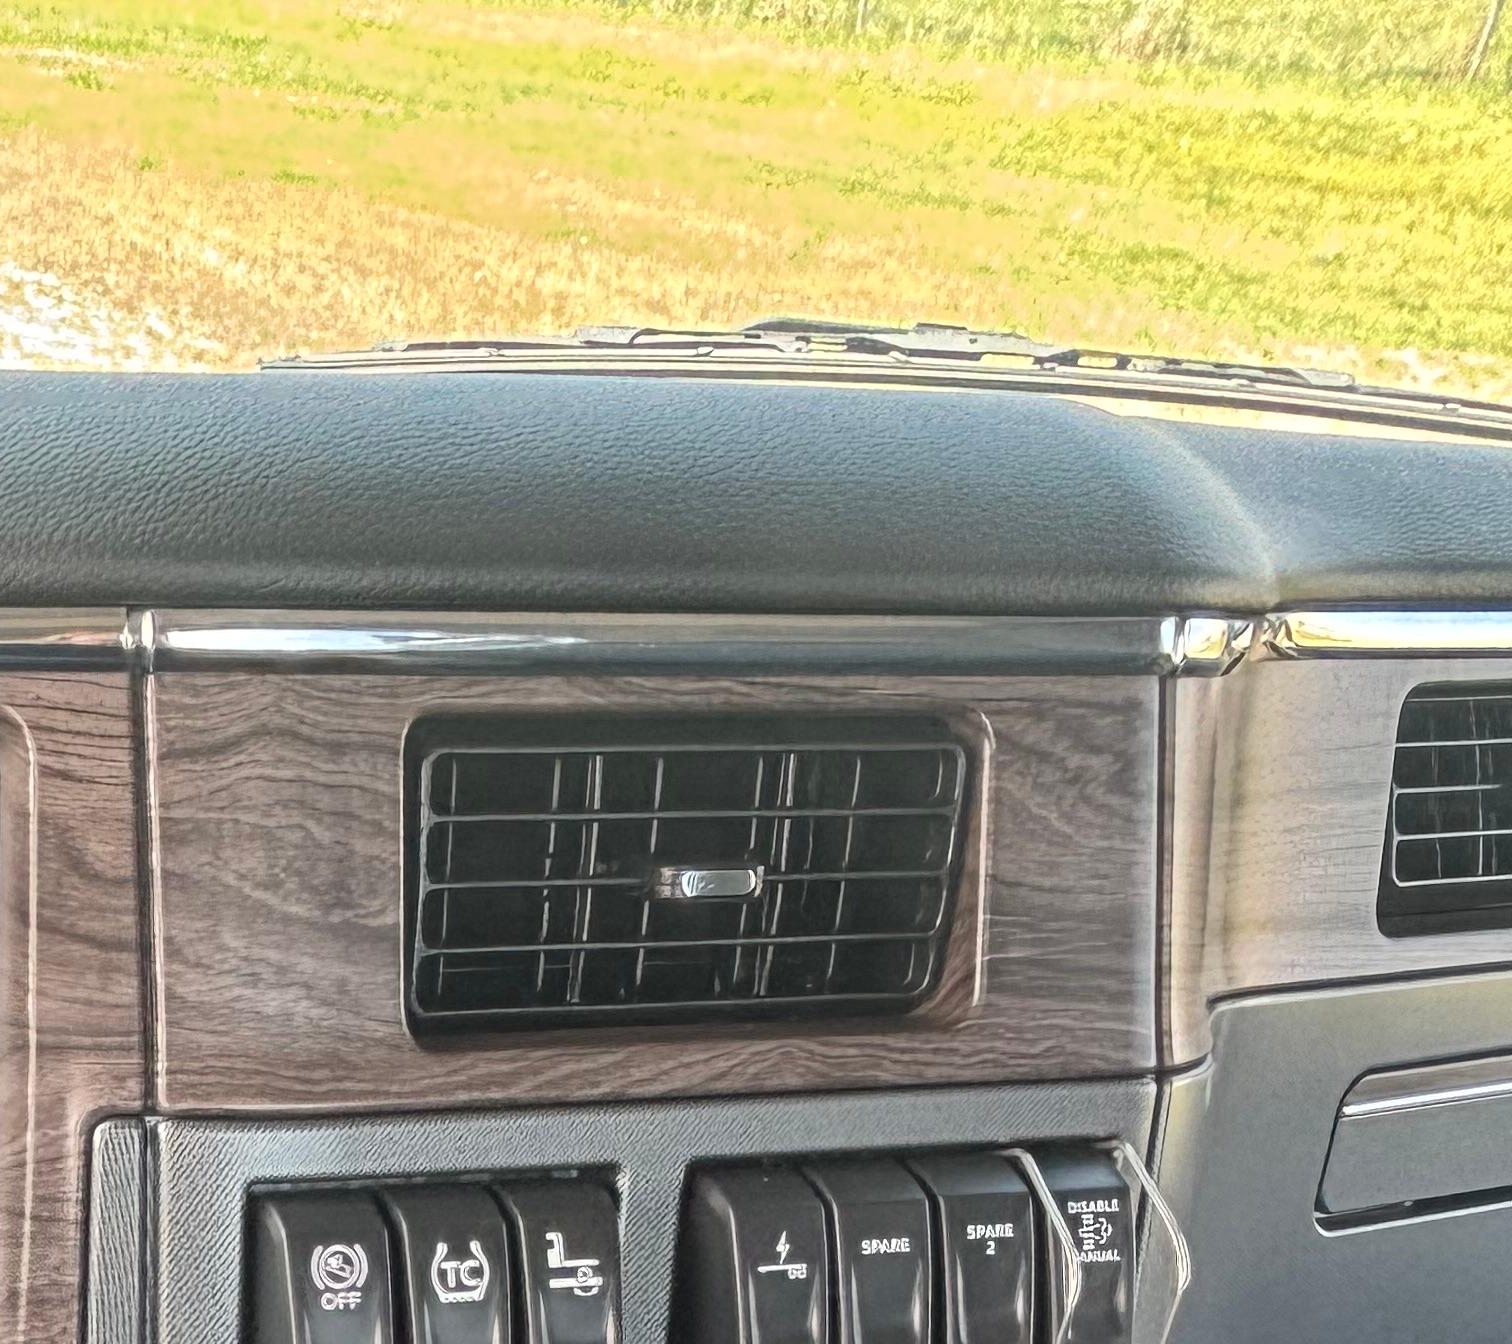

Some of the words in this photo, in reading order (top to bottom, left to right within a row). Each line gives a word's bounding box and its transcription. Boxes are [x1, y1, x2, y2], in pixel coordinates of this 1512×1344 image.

[1067, 1199, 1120, 1213] DISABLE
[966, 1223, 1014, 1239] SPARE
[861, 1237, 911, 1255] SPARE
[985, 1241, 996, 1255] 2
[440, 1259, 481, 1288] TC
[321, 1291, 361, 1310] OFF
